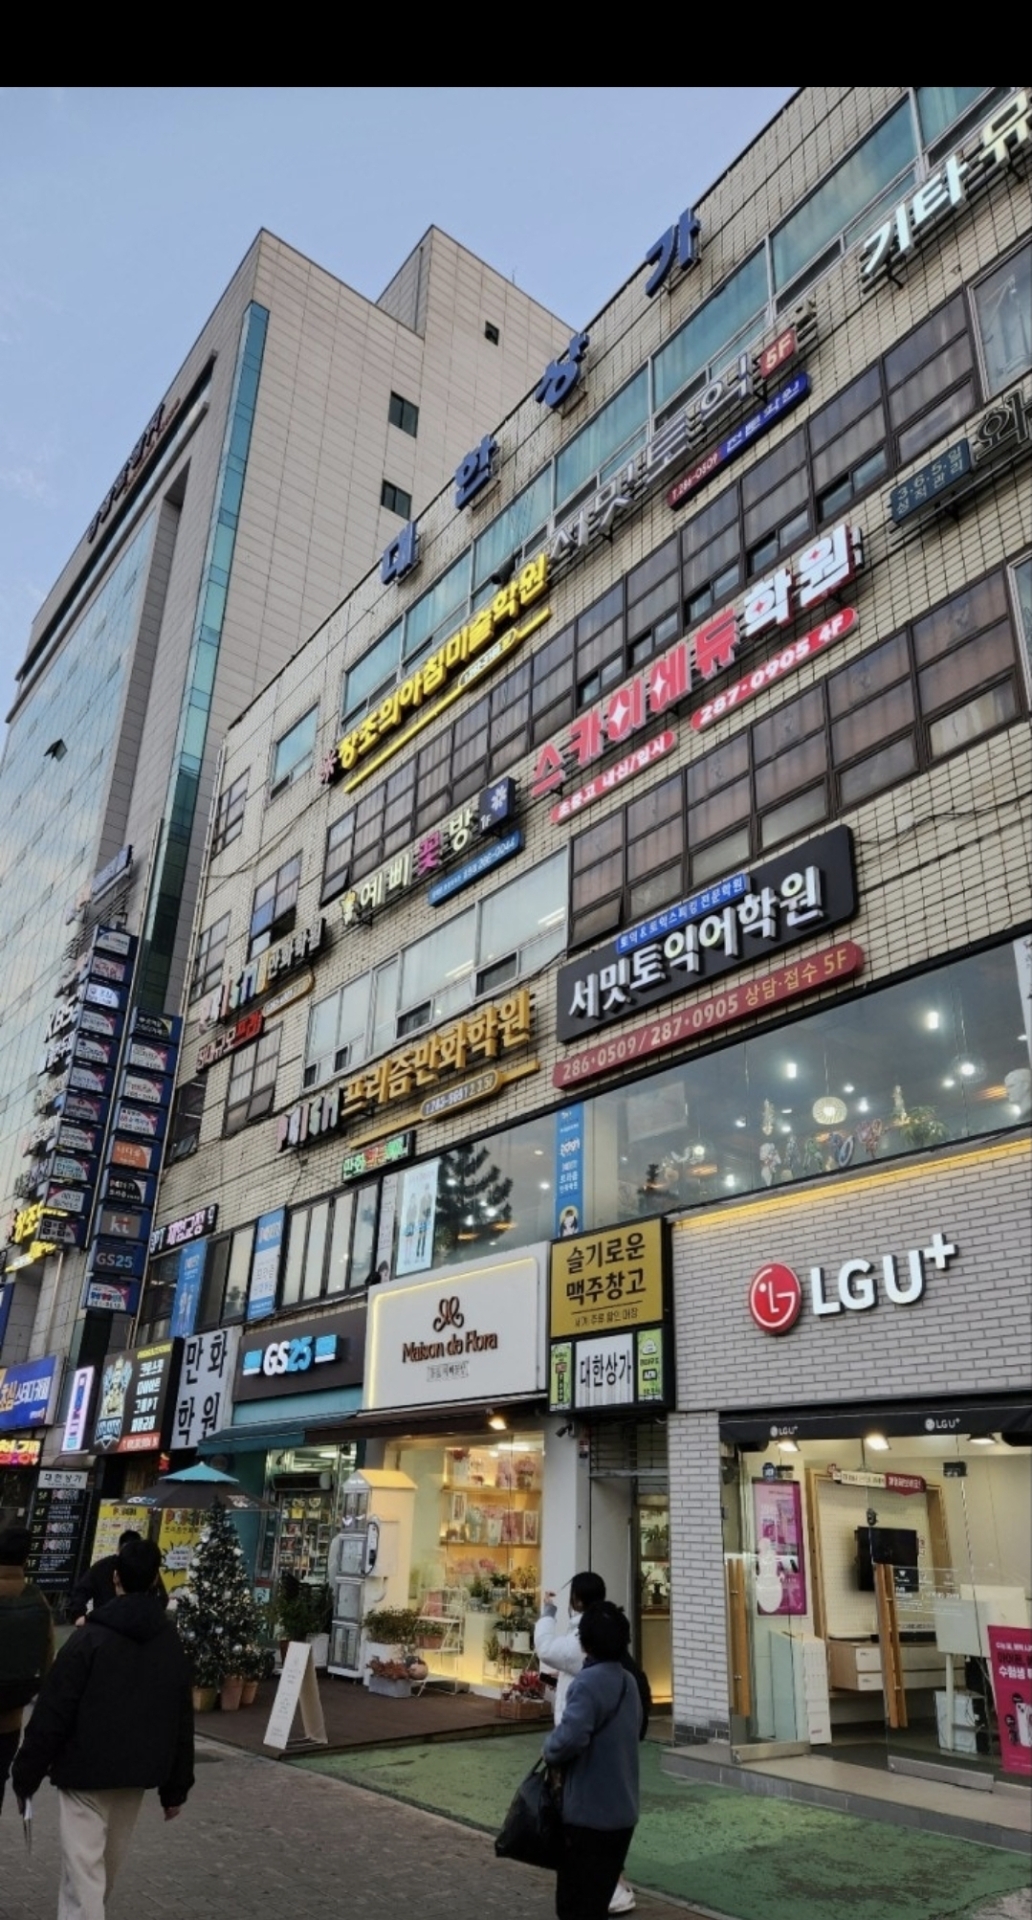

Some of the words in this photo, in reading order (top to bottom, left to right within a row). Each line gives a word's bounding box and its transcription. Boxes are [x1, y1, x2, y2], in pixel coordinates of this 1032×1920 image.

[766, 334, 792, 371] 5F
[569, 865, 824, 1019] 서밋토익어학원
[824, 947, 847, 976] 5F
[341, 989, 533, 1117] 프리즘만화학원
[110, 1215, 129, 1234] kt
[96, 1254, 133, 1268] GS25
[566, 1232, 646, 1275] 슬기로운
[566, 1267, 647, 1306] 맥주창고
[809, 1232, 956, 1316] LGU+
[263, 1336, 312, 1376] GS25
[402, 1341, 444, 1364] Maison
[466, 1330, 498, 1353] Flora
[580, 1350, 631, 1388] 대한상가
